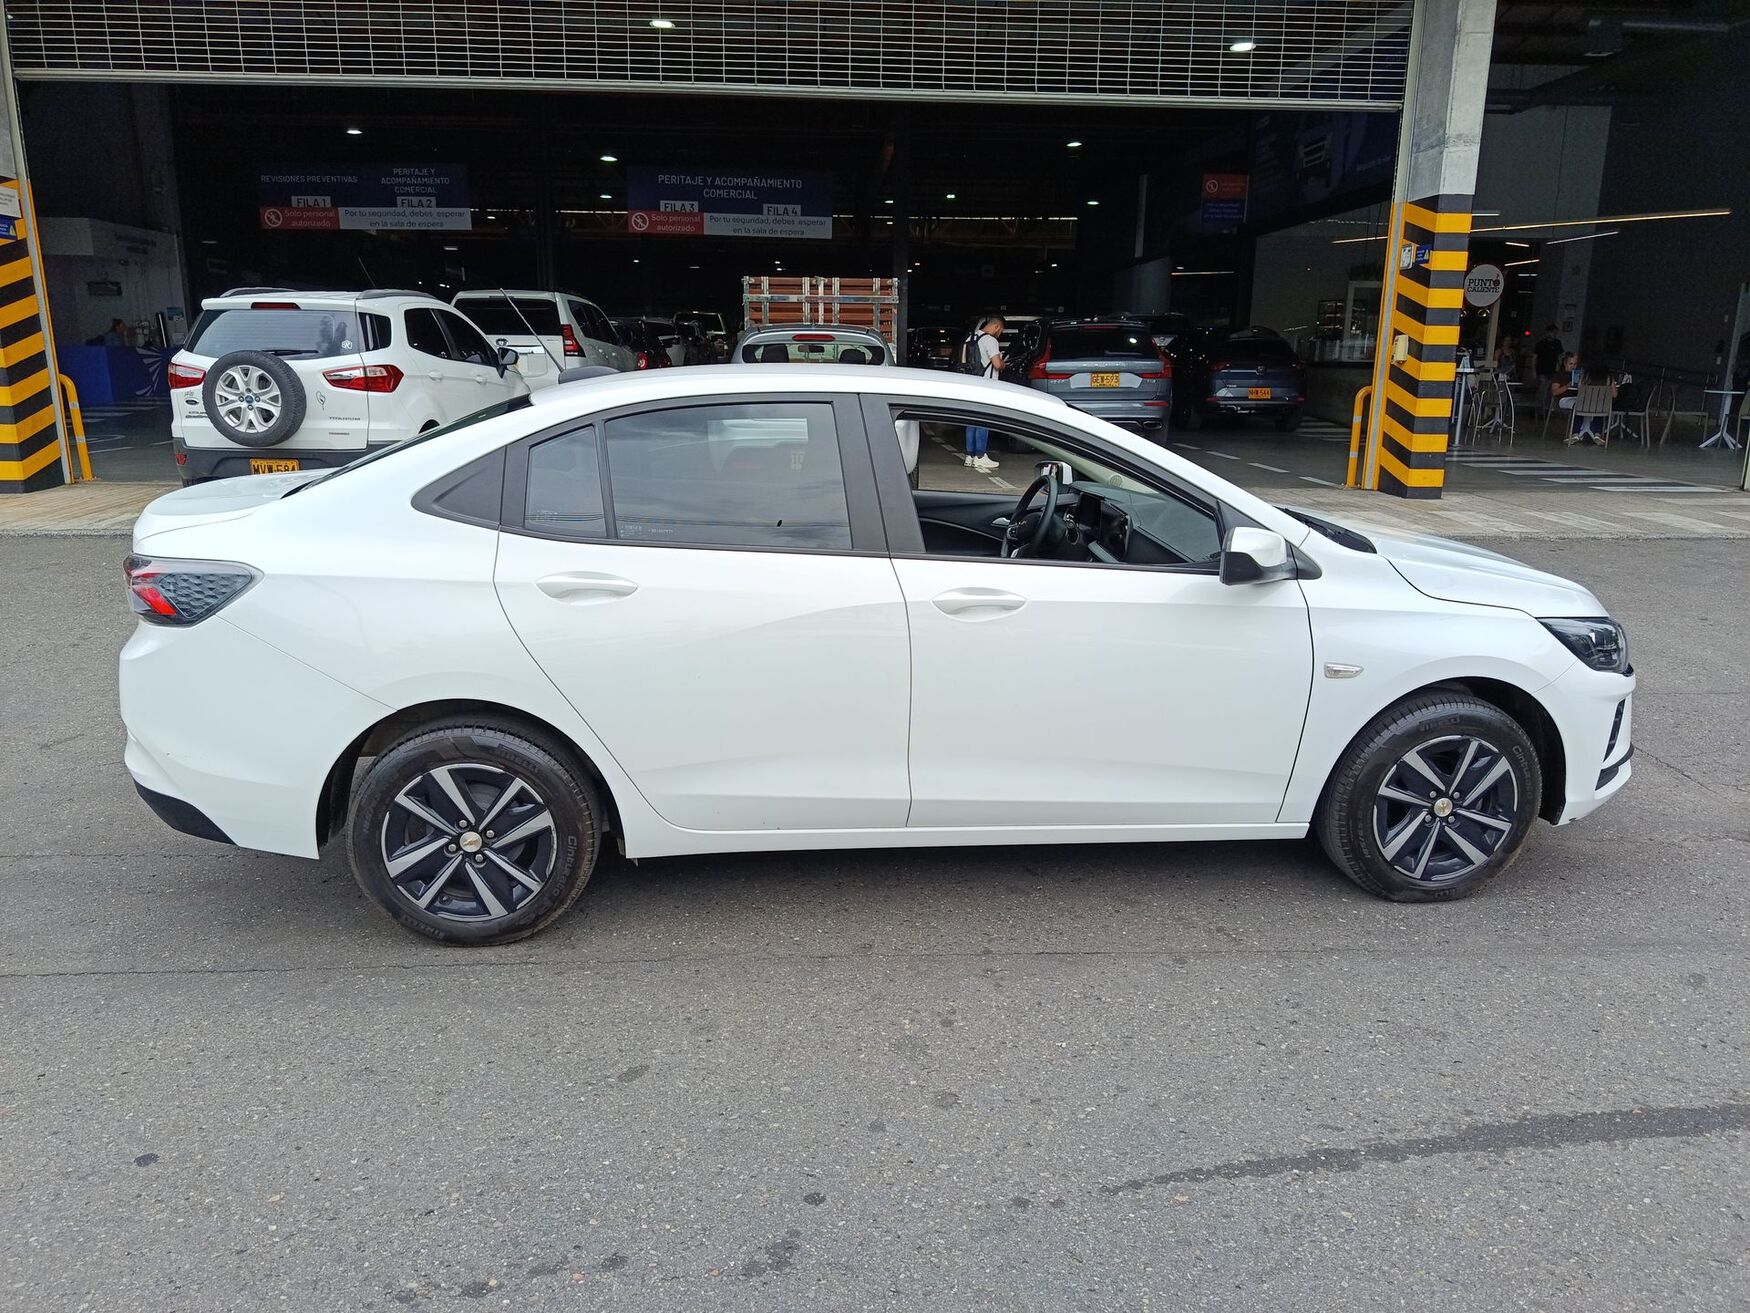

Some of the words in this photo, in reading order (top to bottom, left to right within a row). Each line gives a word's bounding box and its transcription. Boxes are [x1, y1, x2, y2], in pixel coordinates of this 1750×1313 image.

[260, 175, 305, 183] REVISIONES
[306, 175, 358, 184] PREVENTIVAS
[381, 177, 449, 185] ACOMPAÑAMIENTO
[658, 174, 704, 185] PERITAJE
[706, 176, 712, 185] Y
[714, 176, 803, 188] ACOMPAÑAMIENTO
[703, 188, 758, 200] COMERCIAL
[297, 198, 320, 207] FILA
[401, 199, 423, 208] FILA
[426, 199, 432, 208] 2
[664, 203, 686, 212] FILA
[689, 203, 695, 212] 3
[767, 206, 789, 216] FILA
[792, 207, 798, 216] 4
[284, 209, 302, 217] Solo
[303, 209, 335, 218] personal
[436, 210, 465, 218] esperar
[651, 213, 668, 221] Solo
[669, 214, 701, 223] personal
[772, 217, 795, 225] debes
[798, 219, 826, 227] esperar
[656, 223, 696, 232] autorizado
[779, 229, 804, 237] espera
[1468, 278, 1500, 287] PUNTO
